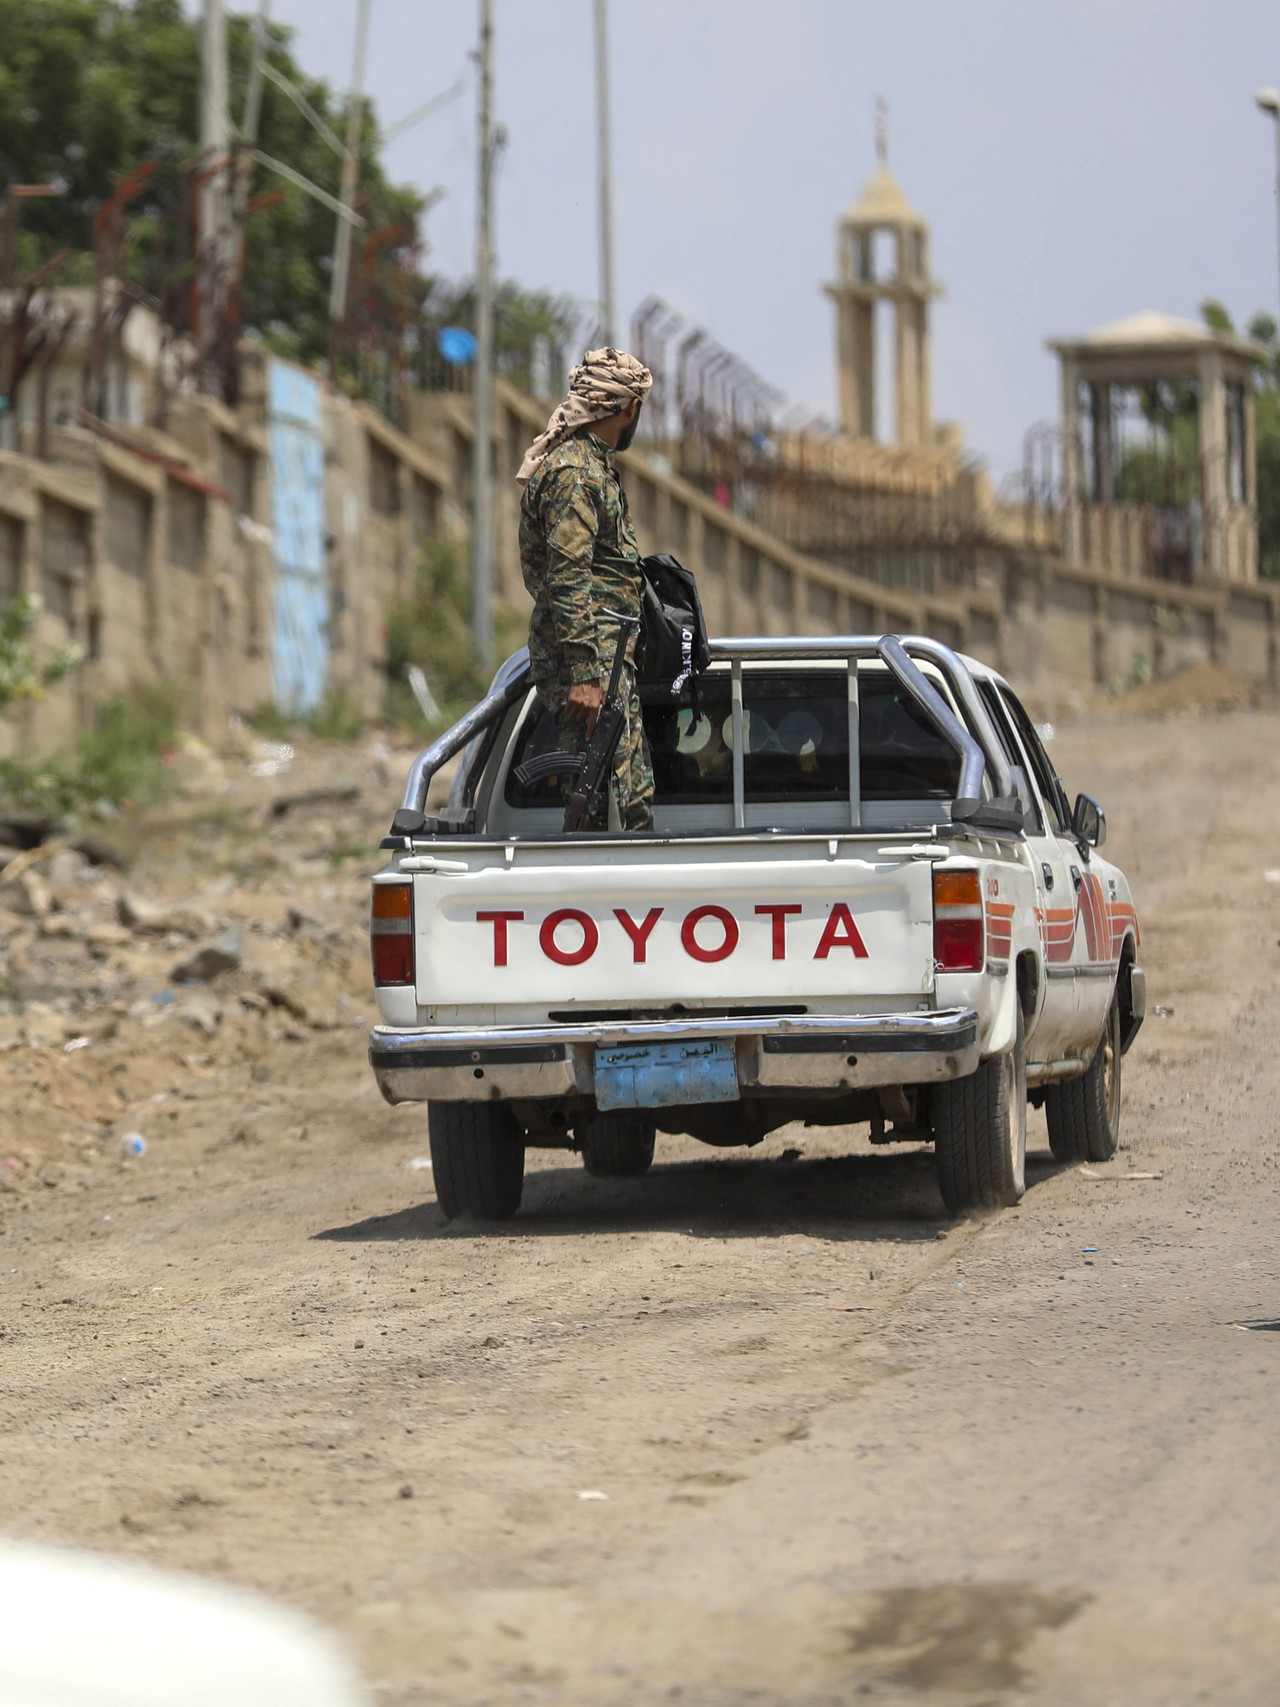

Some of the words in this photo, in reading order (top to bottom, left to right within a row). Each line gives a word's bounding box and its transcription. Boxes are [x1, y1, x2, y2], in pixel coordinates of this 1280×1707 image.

[476, 902, 870, 967] TOYOTA
[607, 1047, 651, 1065] خصوصي
[679, 1043, 718, 1060] اليمن
